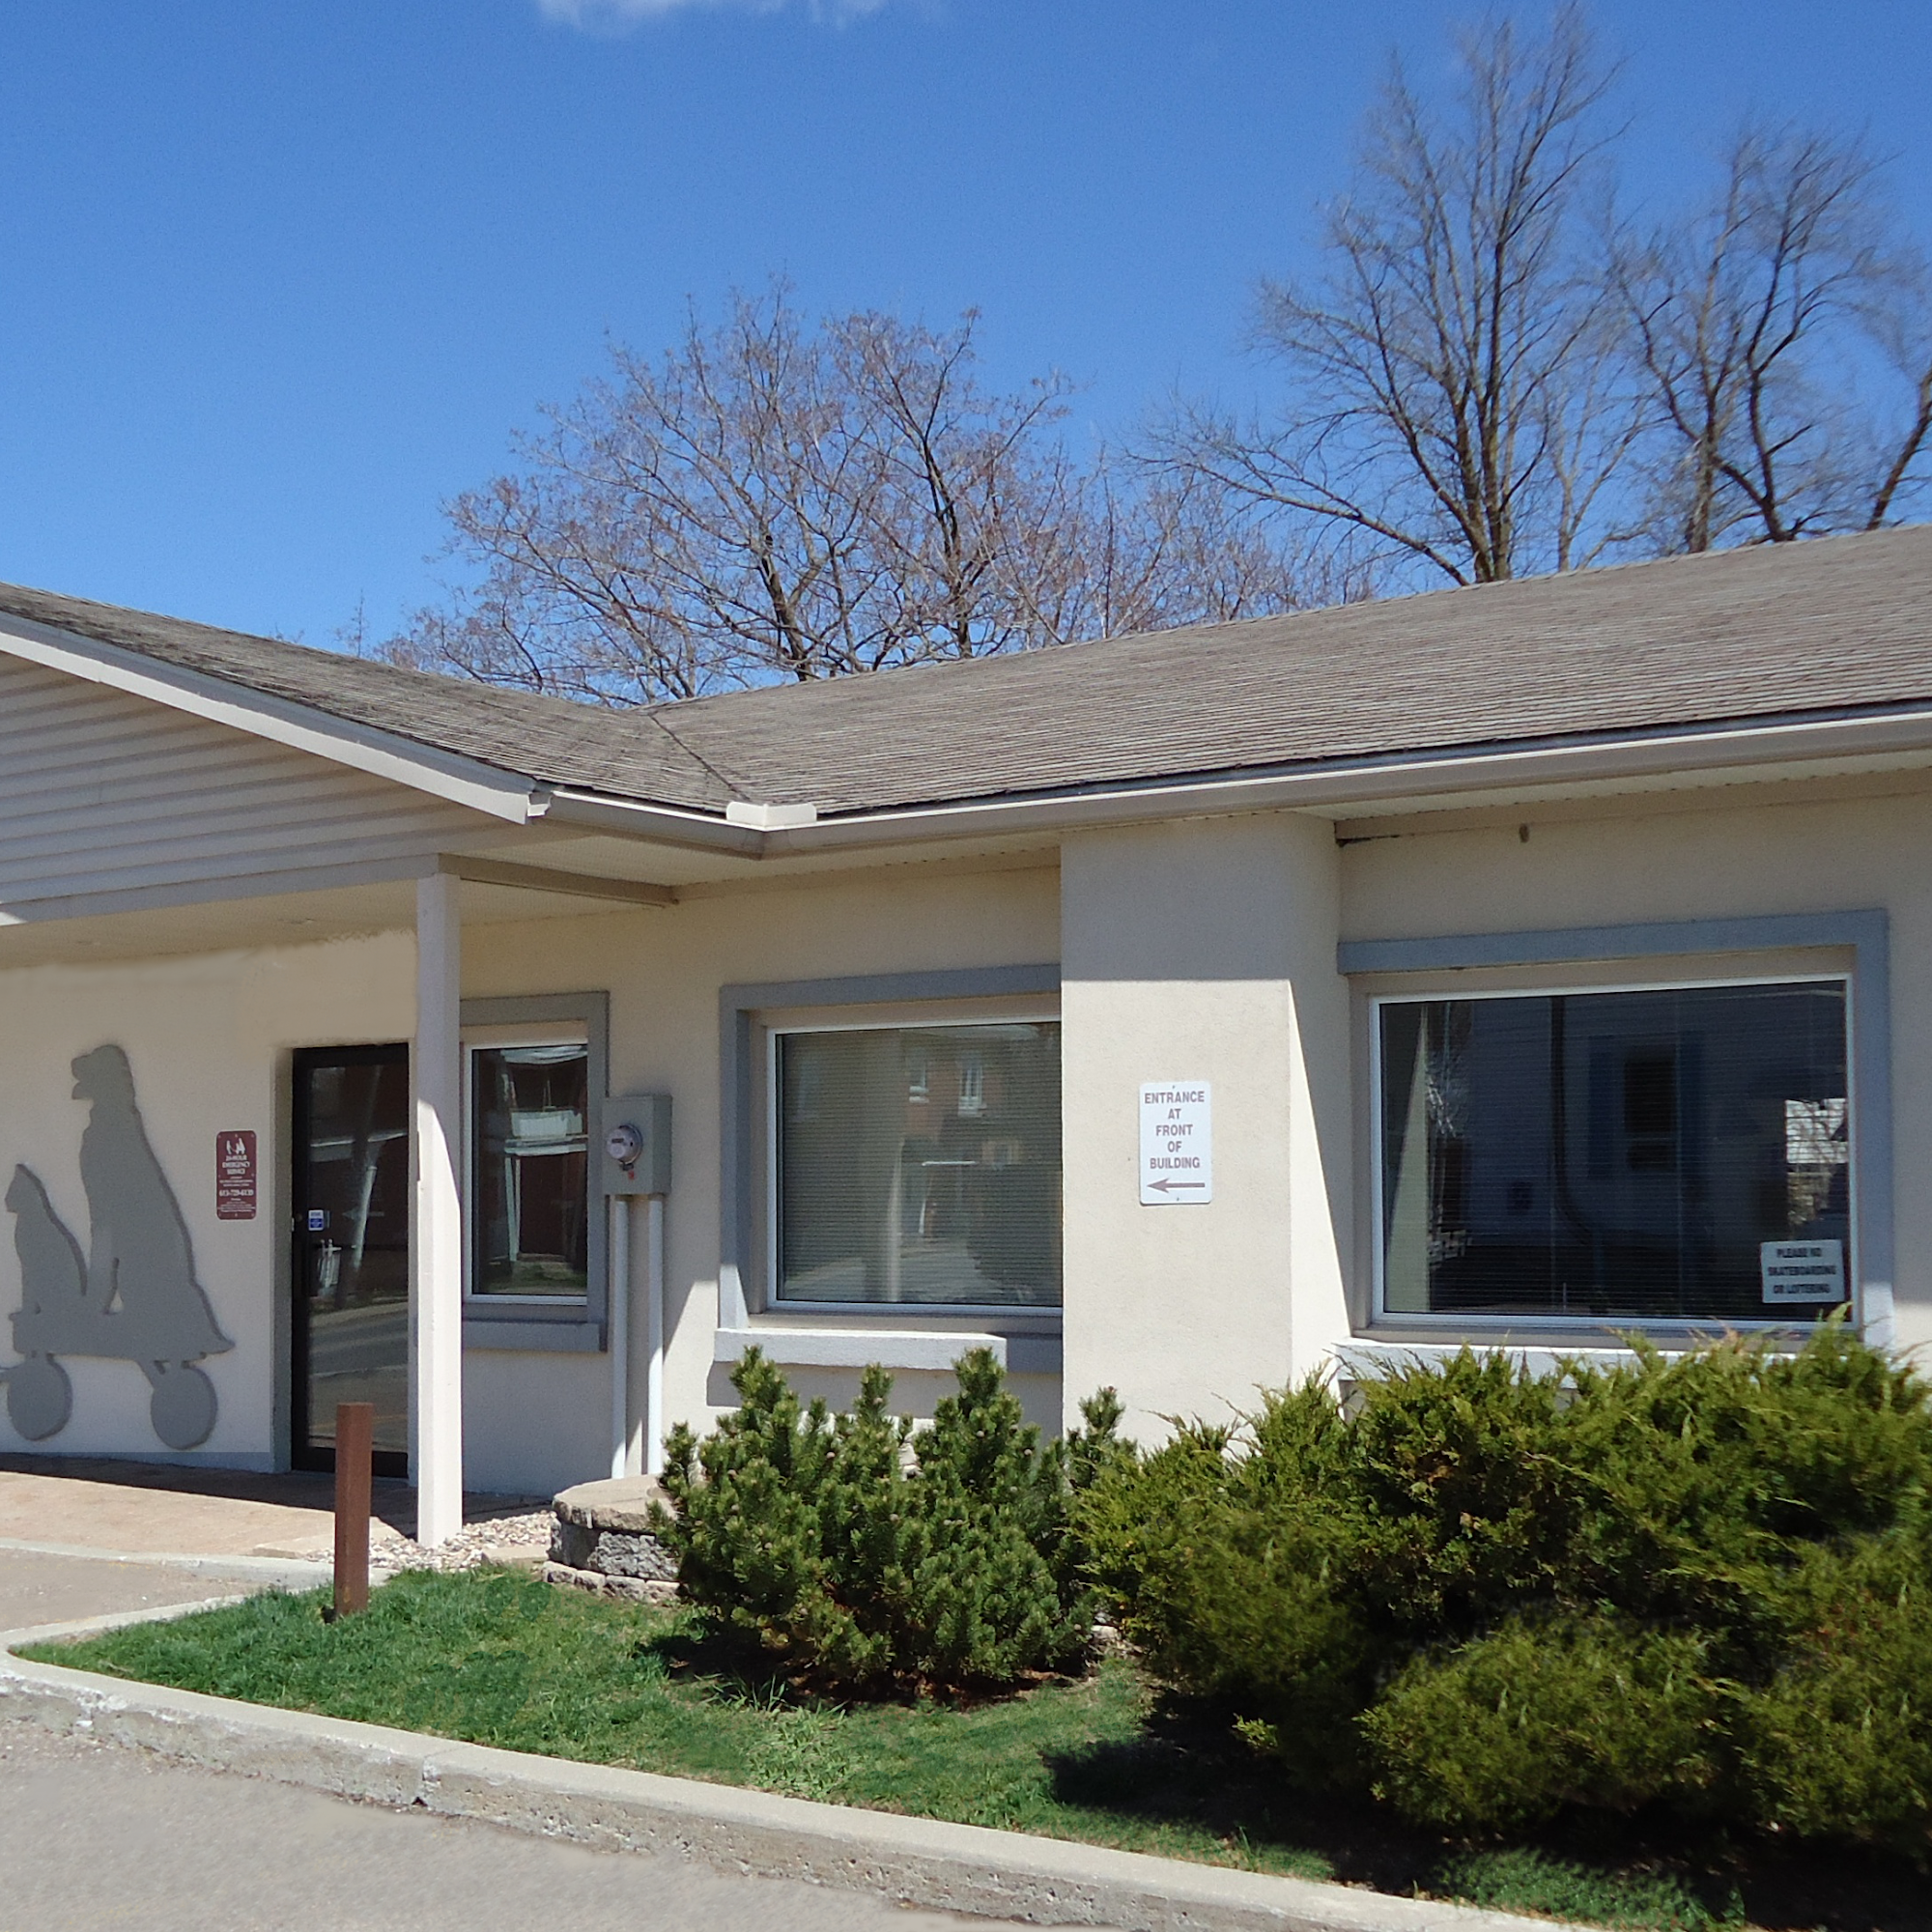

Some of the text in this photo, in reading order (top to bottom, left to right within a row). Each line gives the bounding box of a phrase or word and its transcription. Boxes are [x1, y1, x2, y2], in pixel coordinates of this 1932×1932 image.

[1145, 1091, 1205, 1104] ENTRANCE
[1168, 1108, 1181, 1120] AT
[1155, 1124, 1193, 1136] FRONT
[1167, 1141, 1181, 1152] OF
[1150, 1157, 1200, 1169] BUILDING
